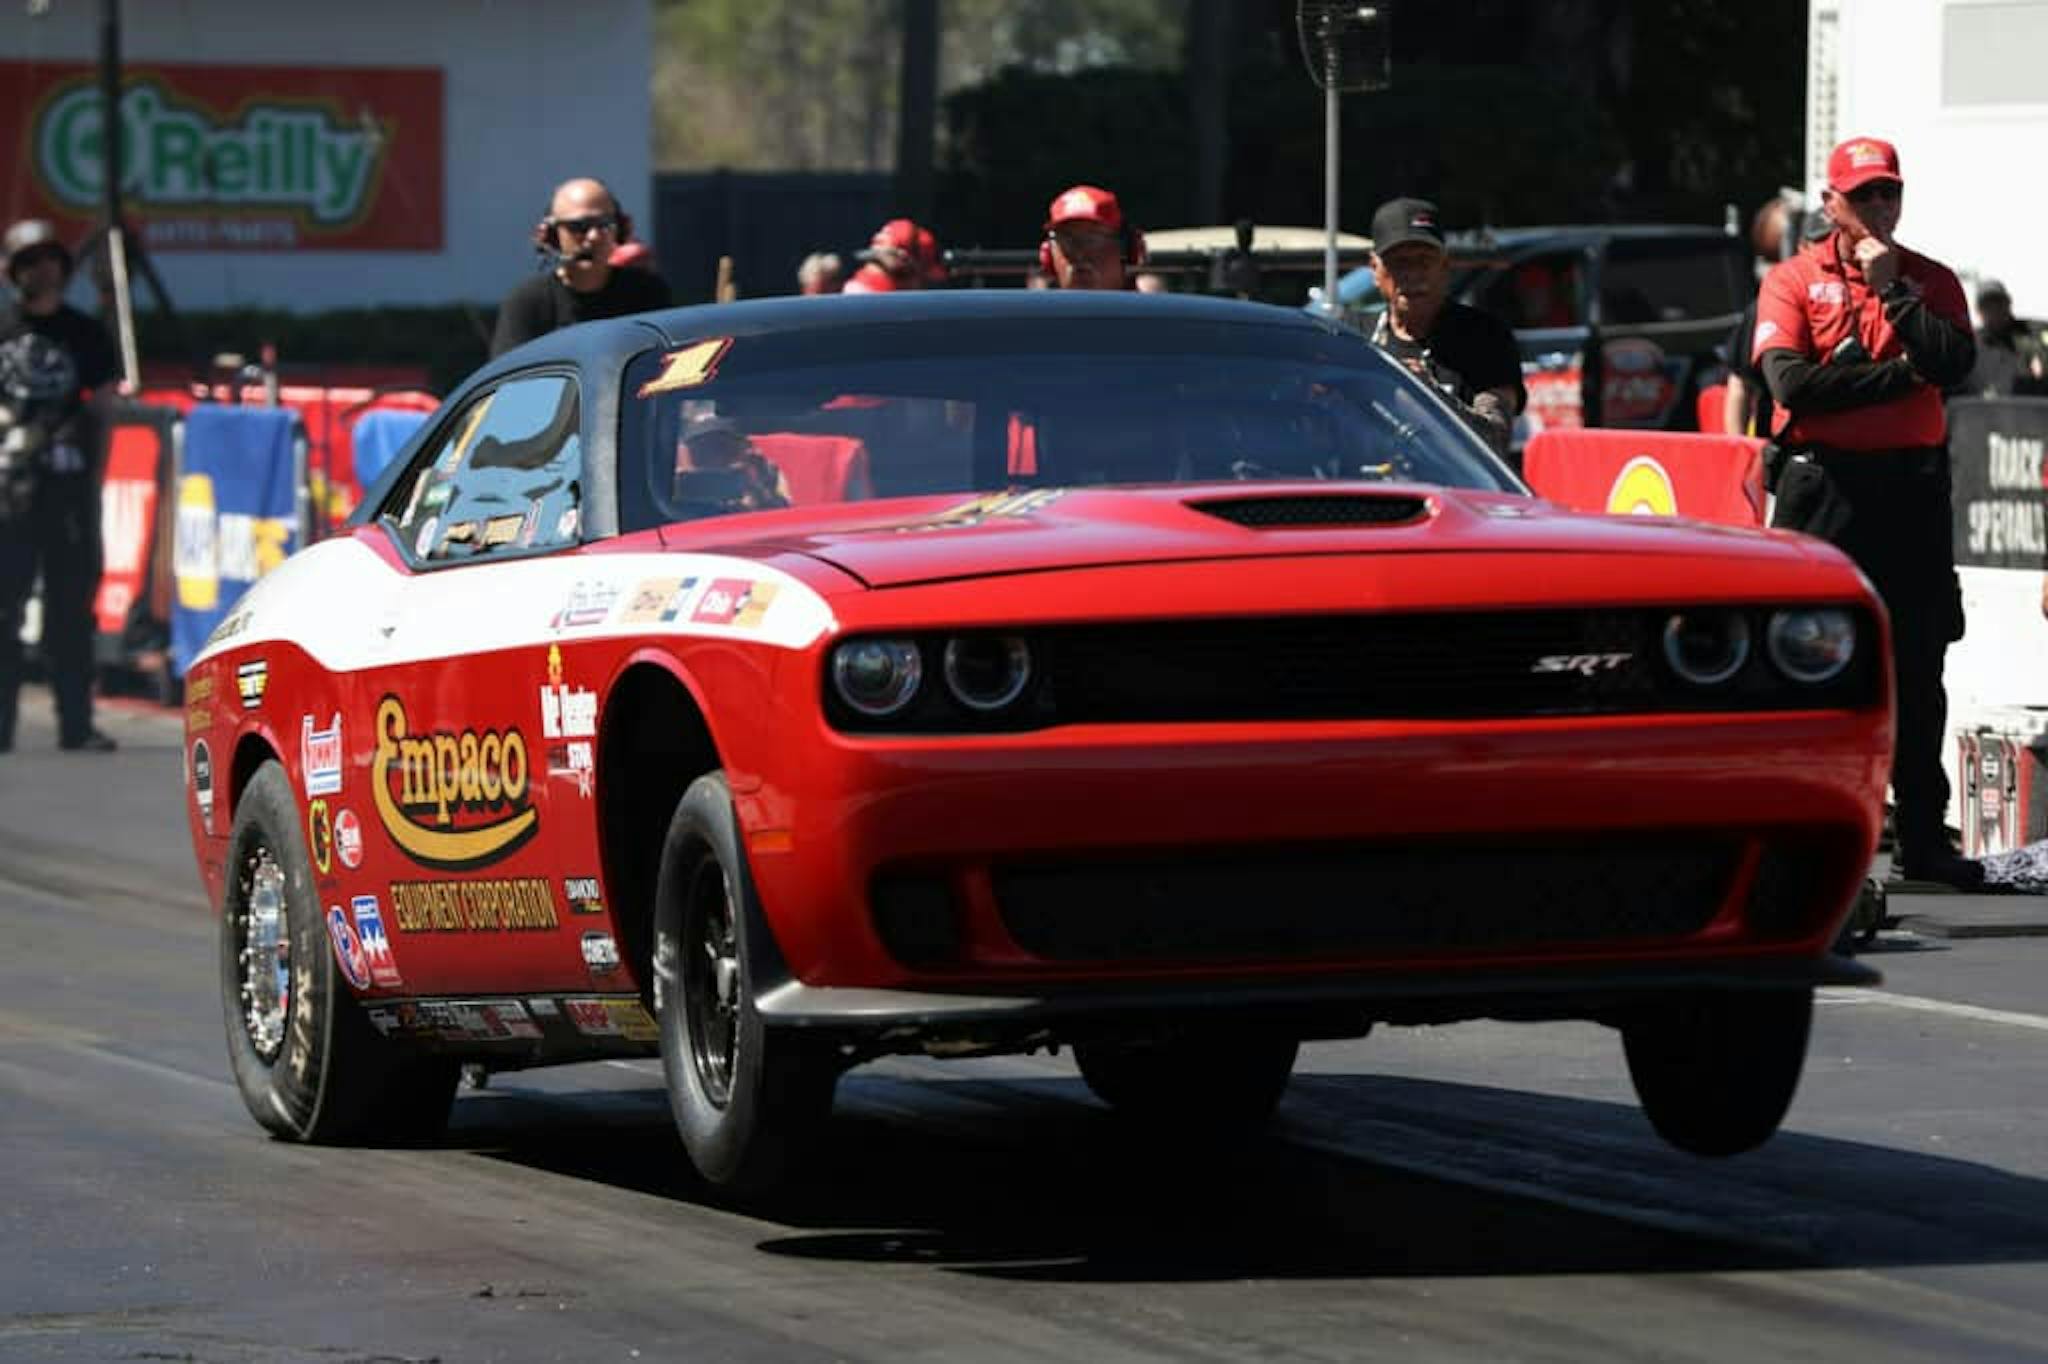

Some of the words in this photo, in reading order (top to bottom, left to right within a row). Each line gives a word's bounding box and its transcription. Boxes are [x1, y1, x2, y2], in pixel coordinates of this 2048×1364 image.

[44, 88, 368, 218] O'Reilly
[1530, 652, 1633, 676] SRT
[371, 695, 539, 862] Empaco
[390, 881, 464, 931] EQUIPMENT
[462, 879, 559, 930] CORPORATION
